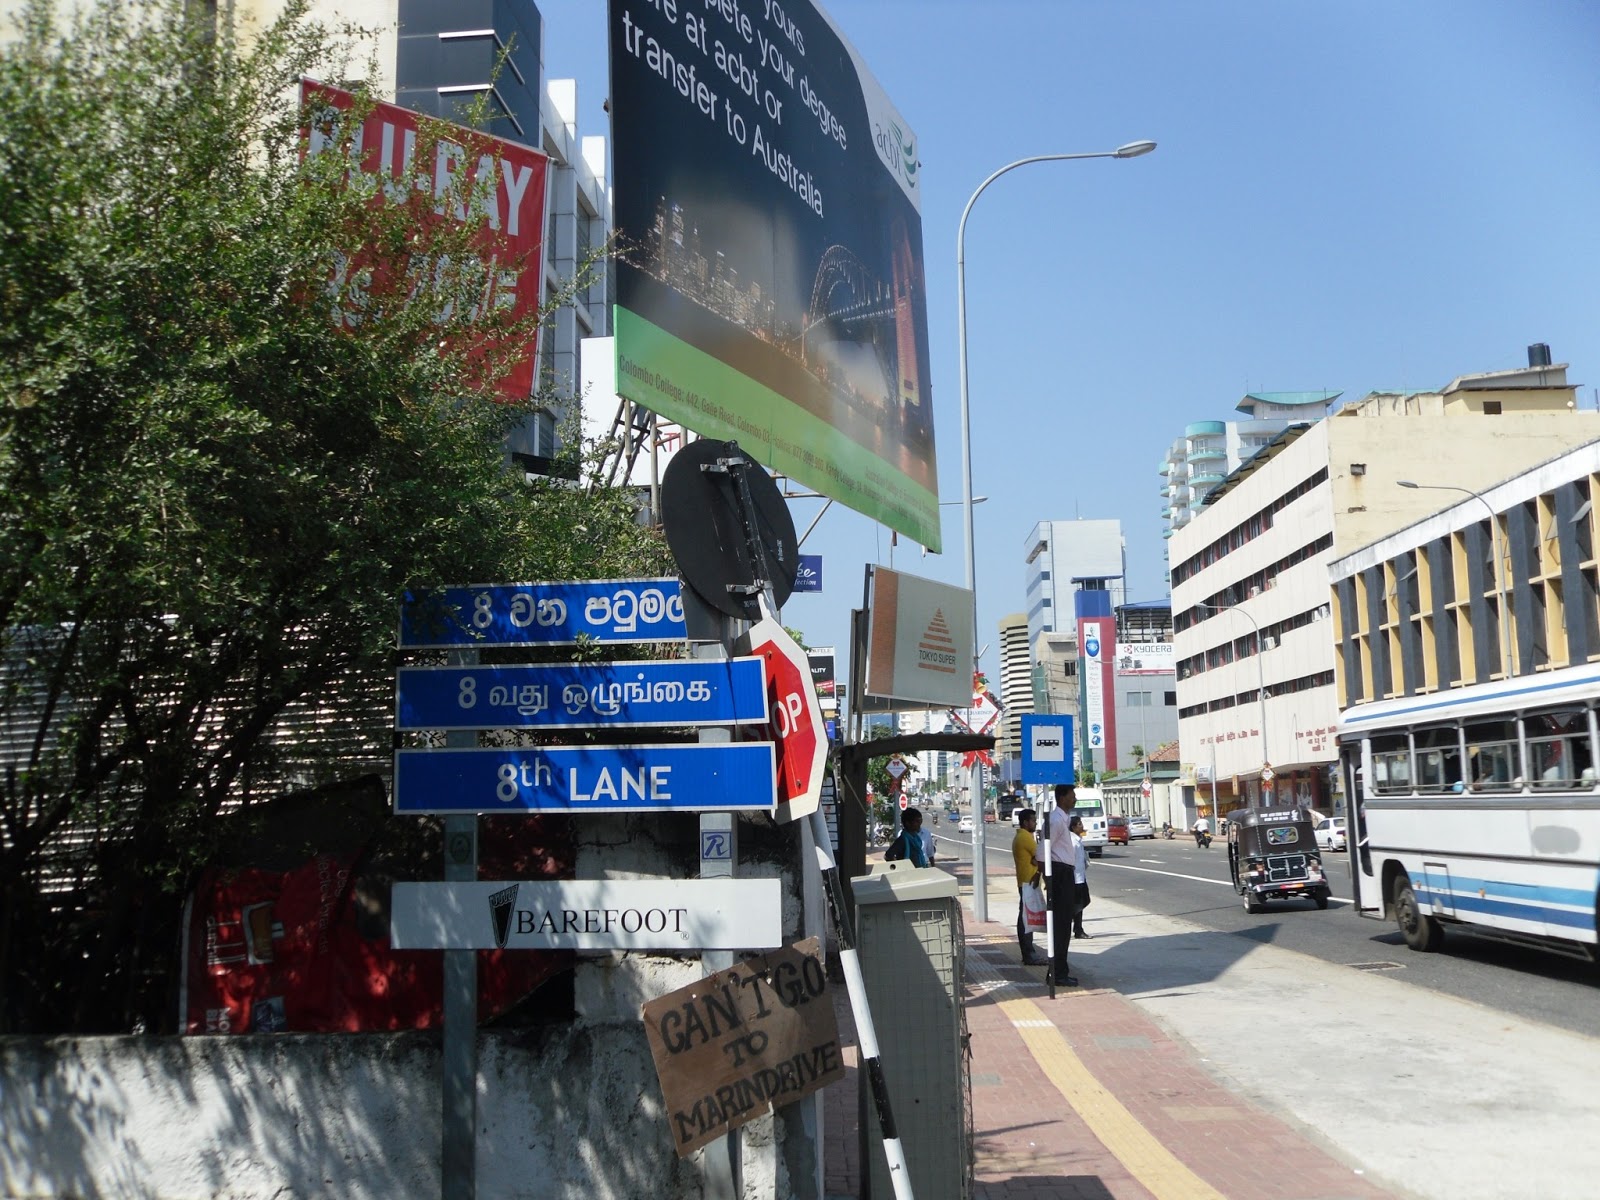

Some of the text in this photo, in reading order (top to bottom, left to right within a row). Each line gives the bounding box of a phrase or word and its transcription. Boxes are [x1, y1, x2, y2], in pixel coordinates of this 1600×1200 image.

[685, 12, 708, 56] at
[714, 40, 760, 105] acbt
[765, 90, 782, 125] or
[757, 29, 795, 90] your
[800, 75, 847, 150] degree
[622, 10, 824, 218] transfer to Australia
[619, 354, 654, 386] Colombo
[655, 373, 684, 402] College:
[473, 593, 493, 629] 8
[510, 592, 567, 628] වන
[918, 649, 956, 665] TOKYO SUPER
[458, 672, 711, 717] 8 வது ஒழுங்கை
[496, 757, 672, 802] 8th LANE
[515, 908, 688, 934] BAREFOOT
[660, 955, 826, 1055] CAN'T GO
[723, 1030, 769, 1069] TO
